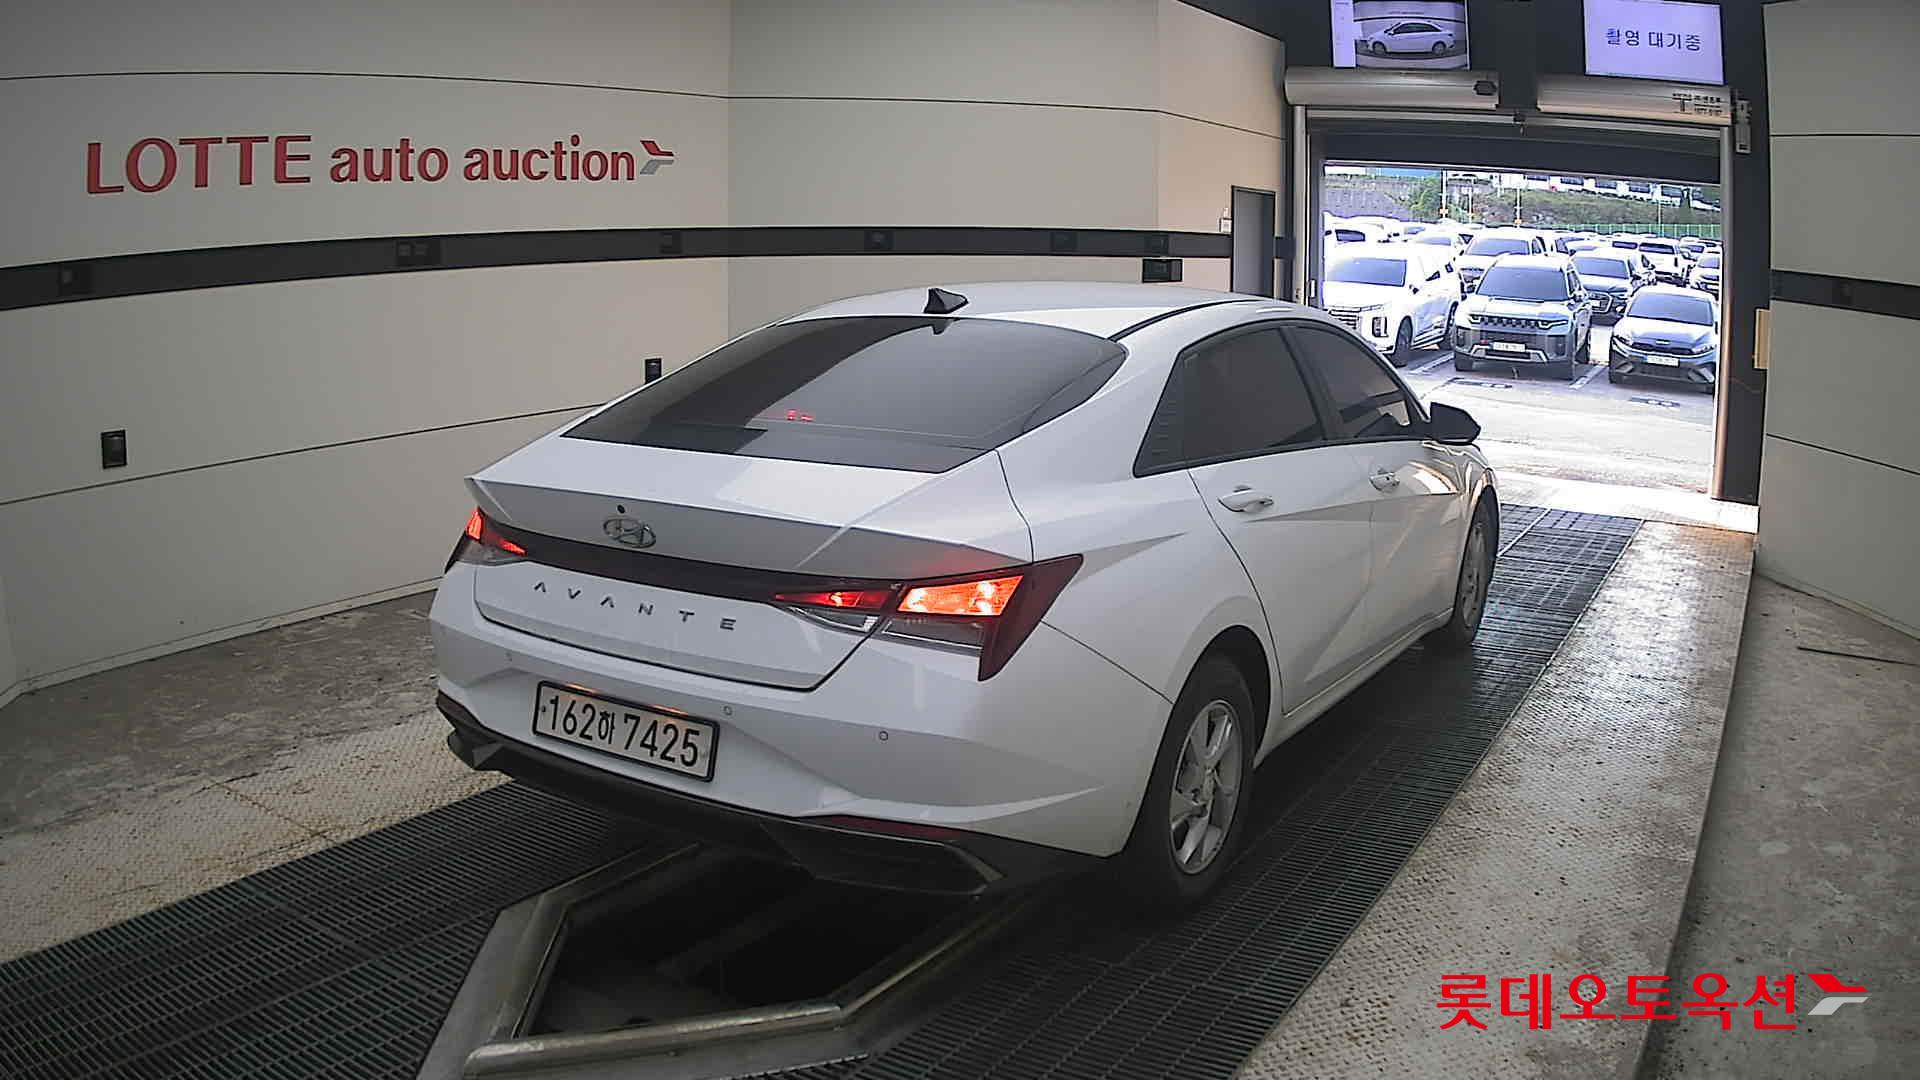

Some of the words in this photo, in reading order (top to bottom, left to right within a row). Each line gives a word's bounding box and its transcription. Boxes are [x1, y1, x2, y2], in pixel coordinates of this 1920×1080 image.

[1648, 31, 1701, 51] 대기중
[86, 135, 312, 194] LOTTE
[329, 137, 449, 183] auto
[463, 134, 636, 183] auction
[533, 581, 737, 631] AVANTE
